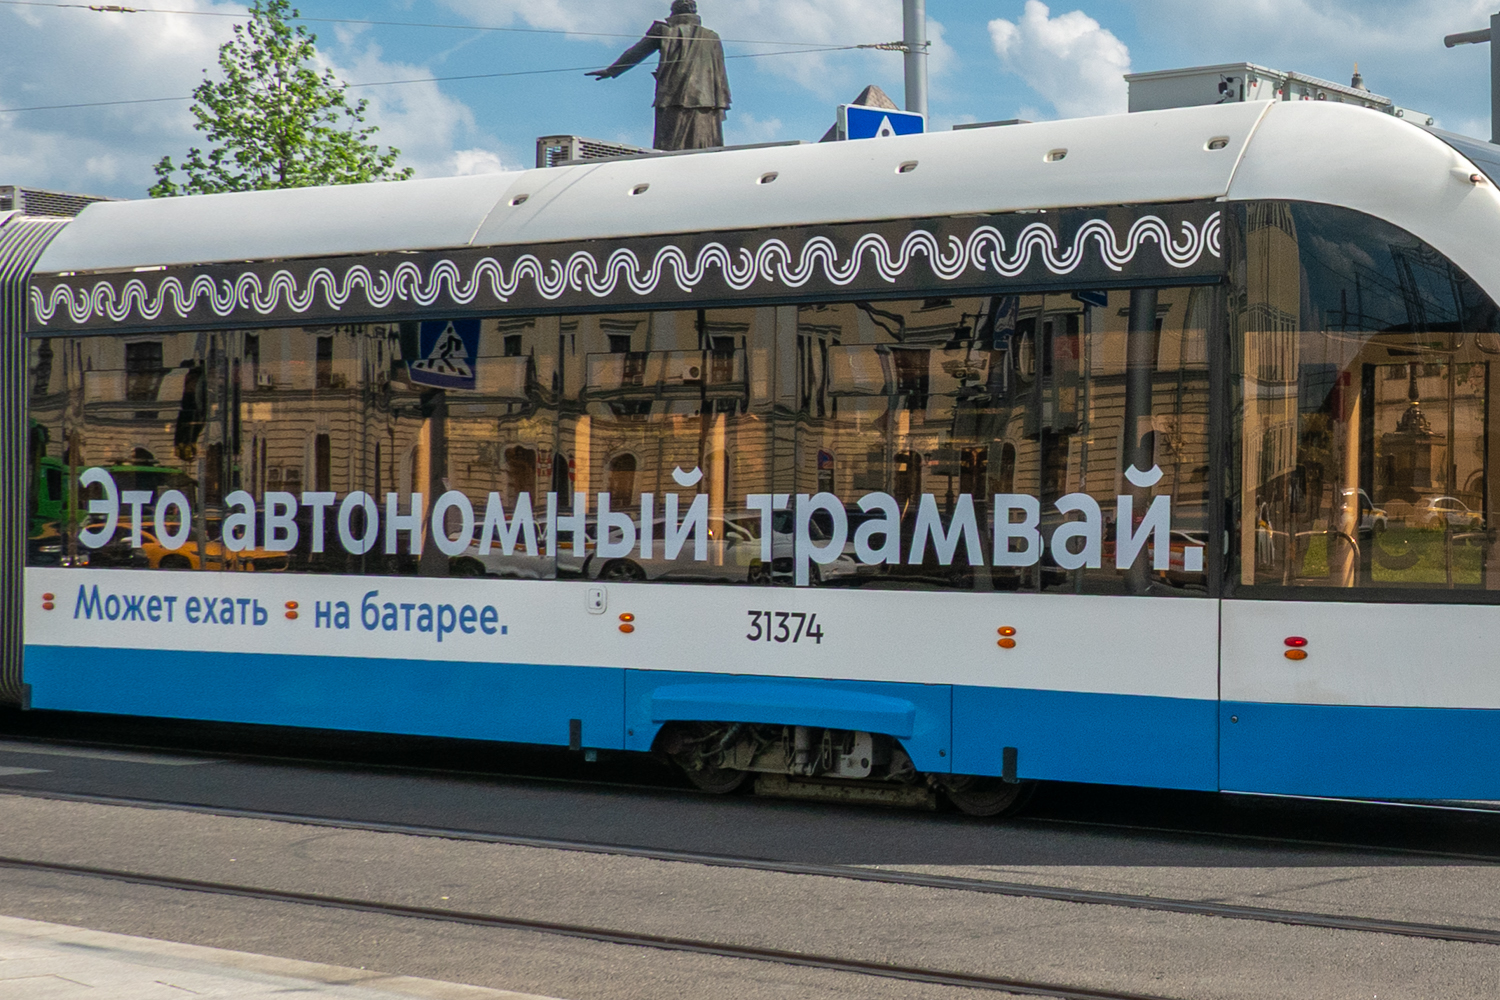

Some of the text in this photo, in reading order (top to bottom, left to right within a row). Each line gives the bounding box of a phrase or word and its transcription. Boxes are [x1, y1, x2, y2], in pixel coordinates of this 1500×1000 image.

[78, 463, 1204, 587] Это автономный трамвай.
[73, 584, 508, 643] Может ехать на батарее.
[746, 610, 824, 645] 31374
